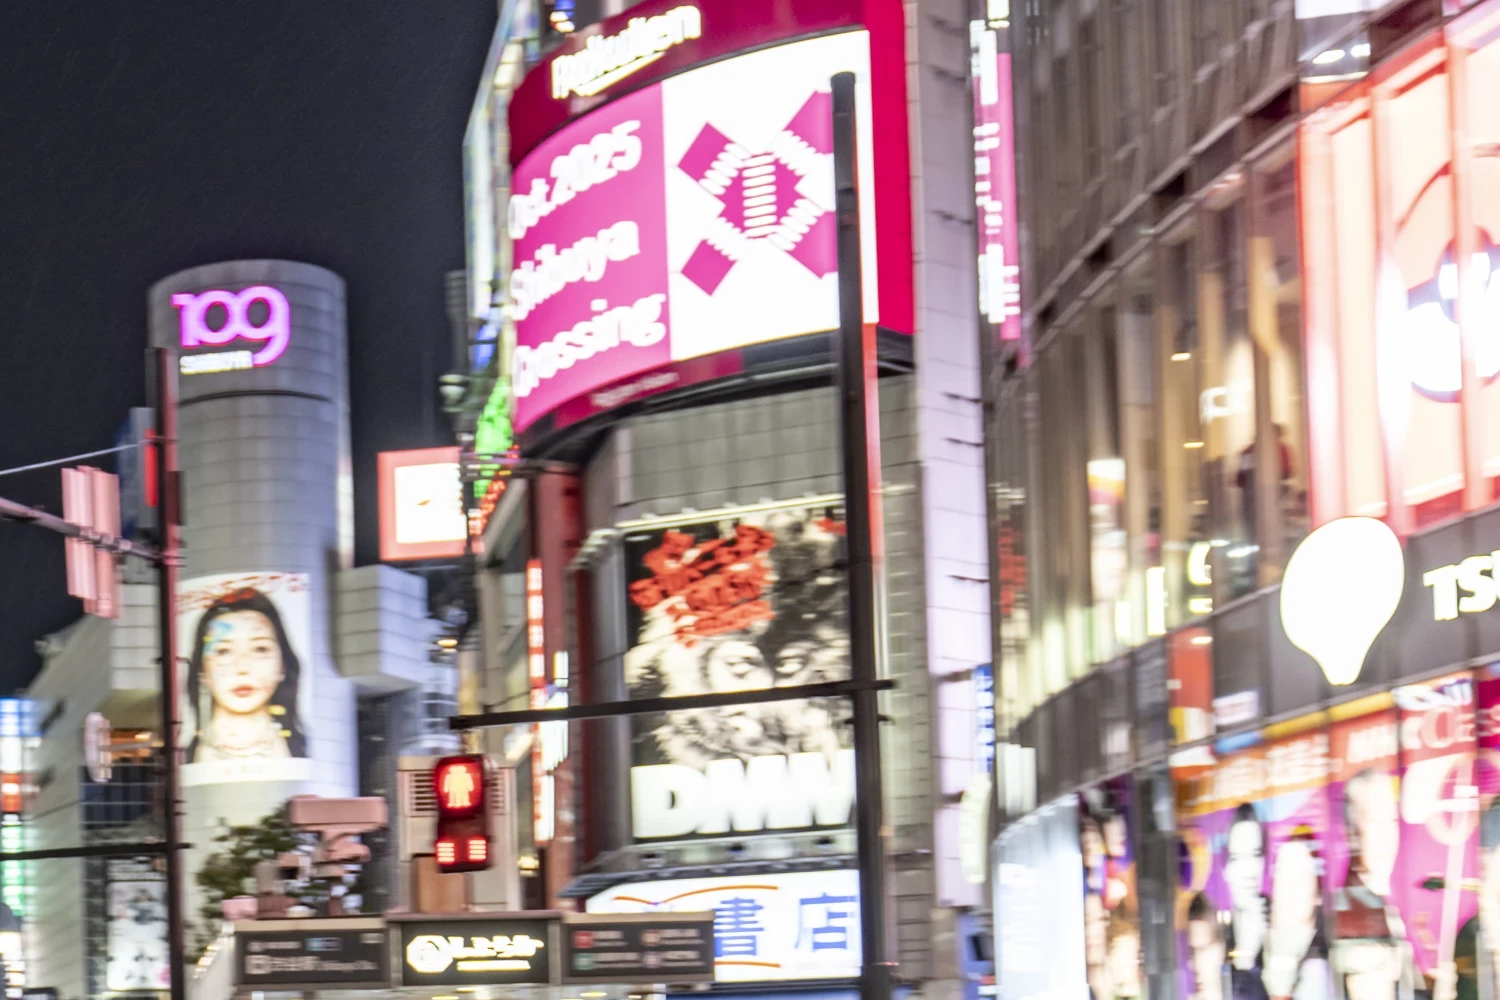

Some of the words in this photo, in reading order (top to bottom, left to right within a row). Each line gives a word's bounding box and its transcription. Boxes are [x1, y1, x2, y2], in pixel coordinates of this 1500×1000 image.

[550, 120, 642, 205] 2025
[171, 285, 291, 368] 109
[1423, 550, 1500, 620] TS
[714, 892, 855, 957] 書店
